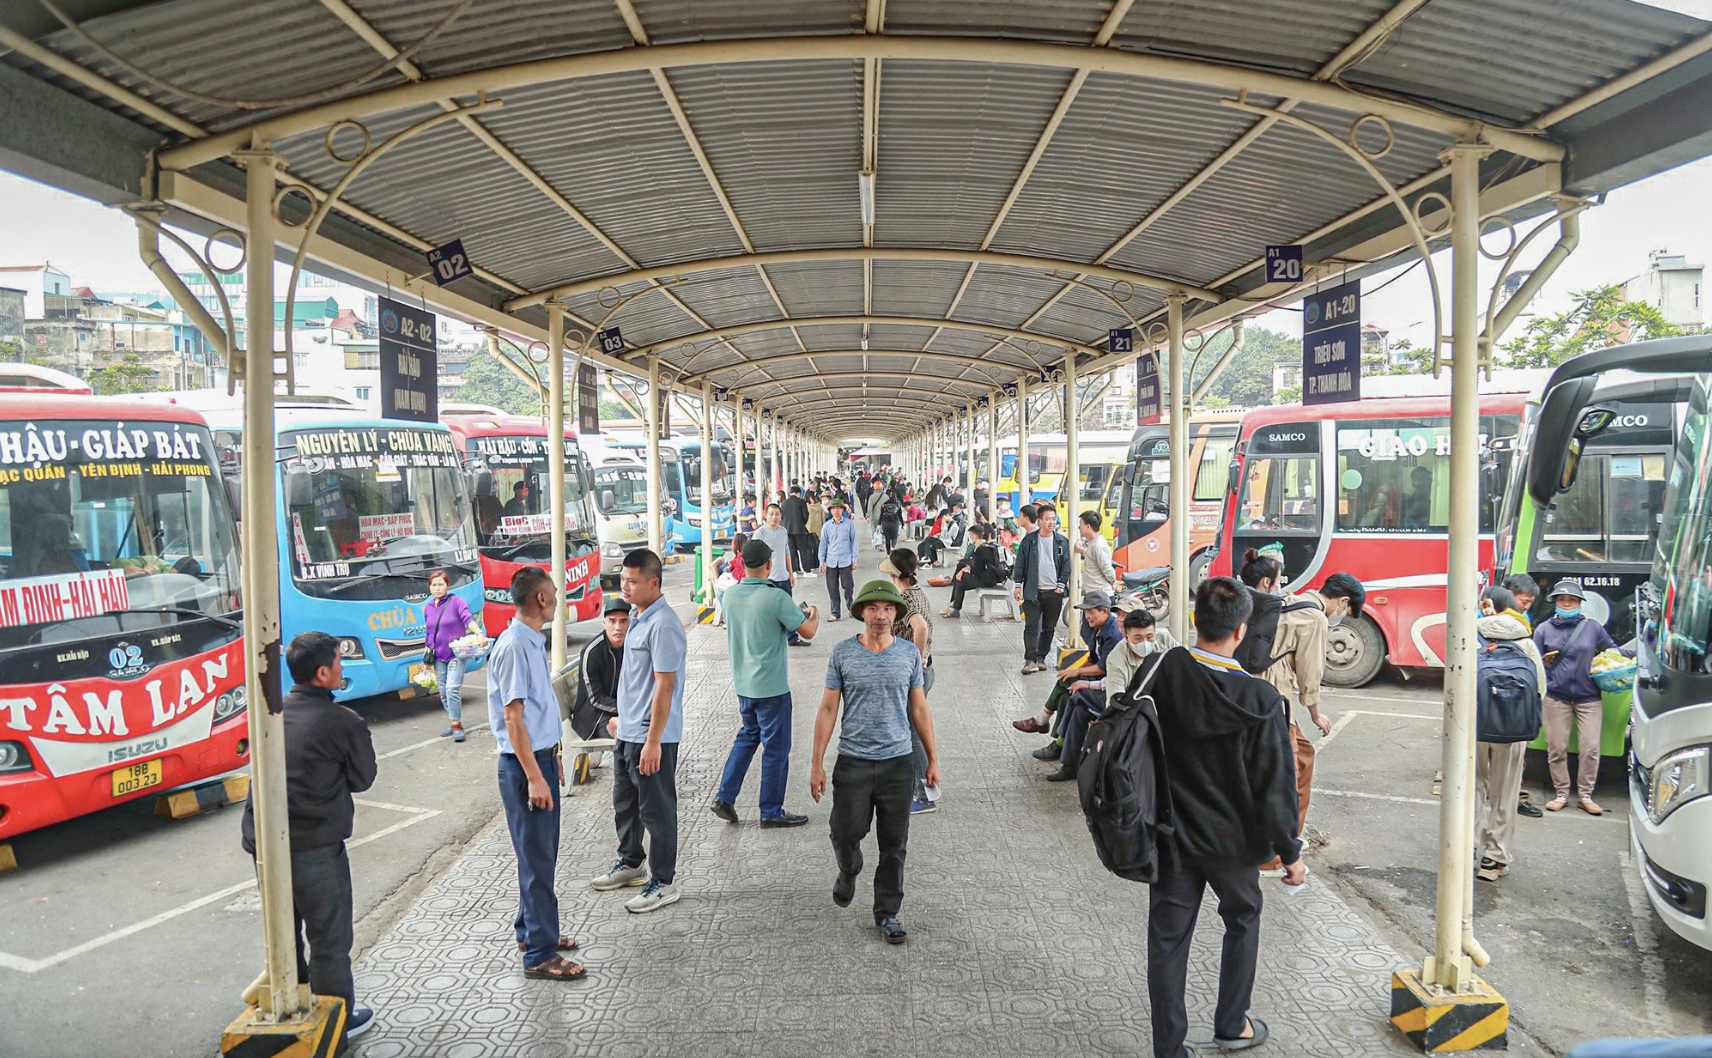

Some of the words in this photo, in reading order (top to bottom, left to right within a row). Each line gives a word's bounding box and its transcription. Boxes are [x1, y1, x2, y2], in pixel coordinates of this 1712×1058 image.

[429, 250, 443, 263] A2
[1268, 248, 1280, 258] A1
[437, 253, 469, 281] 02
[1273, 258, 1300, 279] 20
[1325, 294, 1356, 321] A1-20
[604, 336, 622, 351] 03
[1115, 337, 1131, 350] 21
[1314, 341, 1331, 367] TRIỆU
[1332, 339, 1346, 363] SƠN
[1317, 372, 1338, 394] THANH
[0, 422, 68, 469] HẬU
[82, 422, 149, 460] GIÁP
[153, 424, 202, 460] BÁT
[295, 428, 360, 456] NGUYÊN
[361, 429, 378, 452] LÝ
[388, 428, 420, 452] CHÙA
[423, 429, 454, 454] VÀNG
[1268, 432, 1306, 442] SAMCO
[1358, 434, 1429, 457] GIAO
[79, 464, 115, 478] YÊN
[152, 461, 174, 476] HẢI
[1583, 576, 1620, 587] 62.16.18
[368, 604, 417, 631] CHÙA
[109, 645, 144, 669] 02
[0, 683, 129, 736] TÂM
[146, 653, 229, 727] LAN
[107, 736, 168, 764] ISUZU
[128, 762, 149, 777] 18B
[117, 773, 157, 794] 003.23
